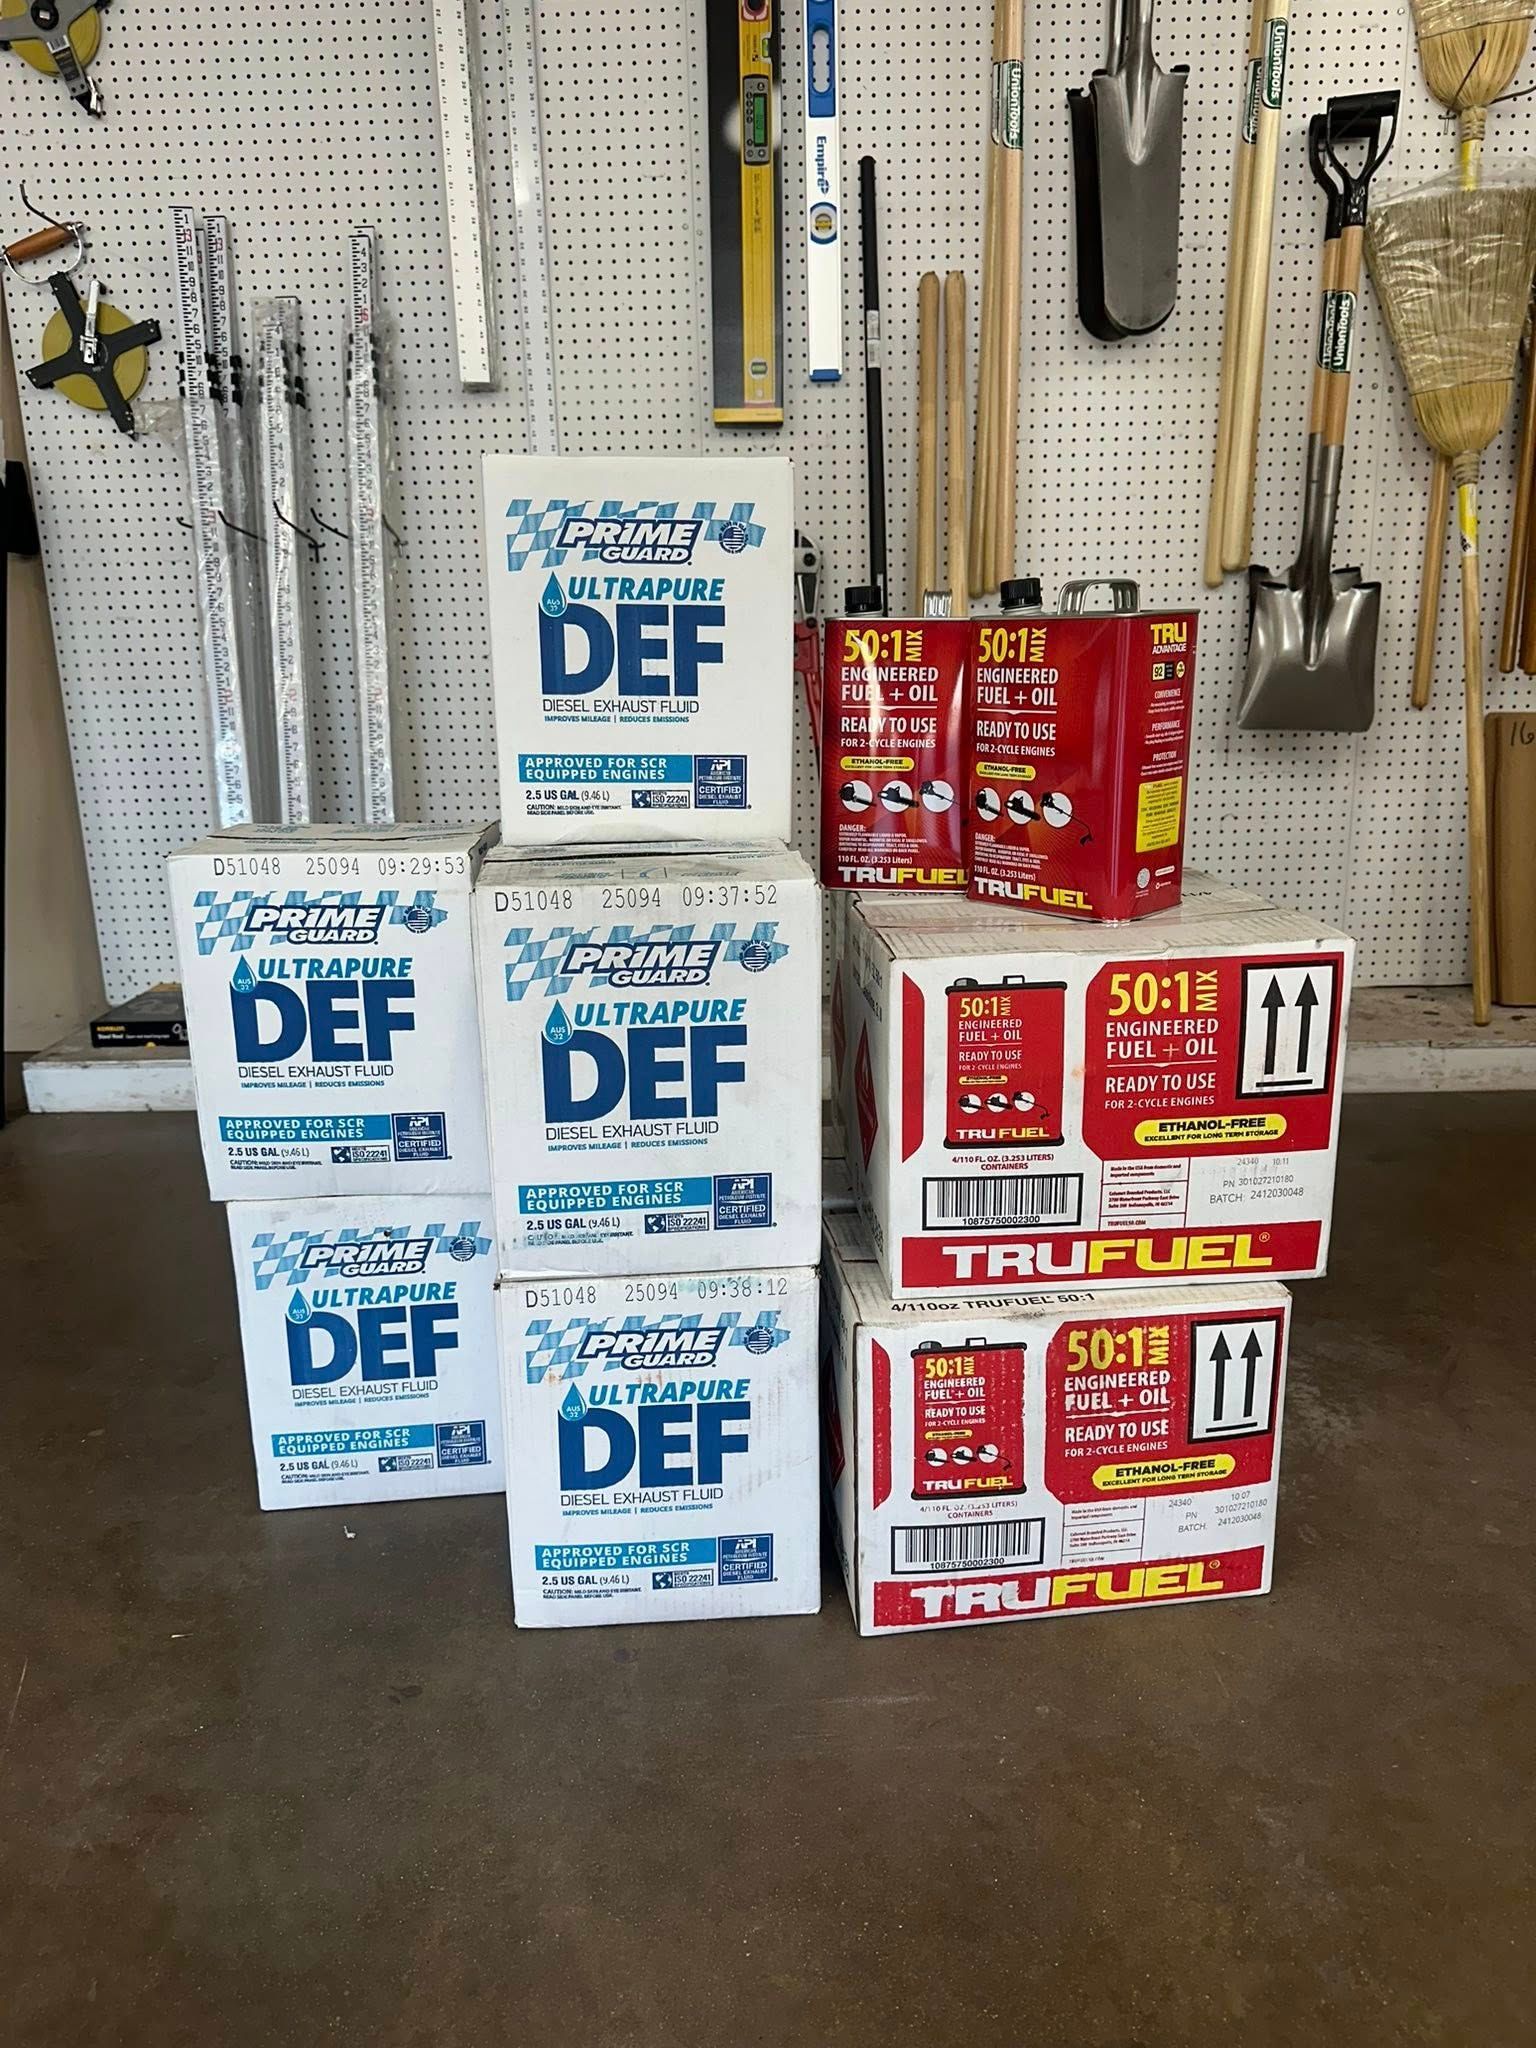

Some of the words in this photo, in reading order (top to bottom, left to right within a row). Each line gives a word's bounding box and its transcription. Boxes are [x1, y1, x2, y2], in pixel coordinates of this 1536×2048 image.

[1271, 25, 1286, 99] UnionTools
[1008, 68, 1022, 140] UnionTools
[815, 135, 827, 187] Empire
[1333, 297, 1351, 366] UnionTools
[560, 520, 693, 546] PRIME
[600, 545, 690, 563] GUARD
[567, 577, 725, 602] ULTRAPURE
[1150, 622, 1187, 645] TRU
[537, 603, 726, 696] DEF
[842, 629, 902, 663] 50:1
[905, 629, 923, 662] MIX
[978, 626, 1028, 664] 50:1
[1029, 627, 1047, 662] MIX
[1151, 643, 1187, 655] ADVANTAGE
[841, 666, 938, 682] ENGINEERED
[976, 666, 1058, 686] ENGINEERED
[1154, 666, 1163, 677] 92
[976, 684, 1010, 705] FUEL
[1031, 686, 1058, 706] OIL
[542, 697, 590, 712] DIESEL
[593, 698, 656, 712] EXHAUST
[660, 699, 699, 714] FLUID
[544, 715, 580, 723] IMPROVES
[619, 716, 651, 724] REDUCES
[652, 716, 689, 724] EMISSIONS
[976, 719, 1011, 739] READY
[1013, 721, 1029, 739] TO
[1032, 722, 1056, 741] USE
[1511, 720, 1535, 747] 16
[976, 741, 989, 753] FOR
[990, 742, 1019, 755] 2-CYCLE
[1020, 744, 1055, 758] ENGINES
[524, 757, 602, 769] APPROVED
[607, 757, 638, 769] FOR
[640, 757, 667, 769] SCR
[983, 763, 1026, 774] ETHANOL-FREE
[525, 768, 598, 781] EQUIPPED
[603, 768, 665, 781] ENGINES
[214, 857, 281, 876] D51048
[306, 857, 360, 875] 25094
[378, 857, 465, 875] 09:29:53
[493, 889, 573, 913] D51048
[601, 886, 660, 910] 25094
[681, 883, 777, 908] 09:37:52
[247, 906, 379, 931] PRIME
[286, 927, 376, 945] GUARD
[565, 942, 711, 972] PRIME
[256, 955, 413, 980] ULTRAPURE
[609, 966, 708, 988] GUARD
[1107, 970, 1189, 1016] 50:1
[1194, 969, 1219, 1012] MIX
[229, 978, 419, 1064] DEF
[573, 997, 747, 1028] ULTRAPURE
[1105, 1018, 1219, 1038] ENGINEERED
[1106, 1039, 1157, 1060] FUEL
[1185, 1036, 1218, 1056] OIL
[238, 1065, 285, 1079] DIESEL
[288, 1064, 351, 1078] EXHAUST
[354, 1064, 394, 1077] FLUID
[539, 1023, 747, 1124] DEF
[1104, 1075, 1157, 1093] READY
[1161, 1074, 1182, 1091] TO
[1185, 1072, 1216, 1089] USE
[1104, 1099, 1124, 1109] FOR
[1127, 1097, 1168, 1108] 2-CYCLE
[1170, 1095, 1215, 1107] ENGINES
[545, 1124, 598, 1141] DIESEL
[602, 1121, 671, 1139] EXHAUST
[675, 1120, 719, 1136] FLUID
[1158, 1117, 1266, 1132] ETHANOL-FREE
[547, 1143, 587, 1152] IMPROVES
[588, 1141, 622, 1150] MILEAGE
[630, 1139, 666, 1148] REDUCES
[667, 1137, 708, 1147] EMISSIONS
[1144, 1134, 1185, 1142] EXCELLENT
[1225, 1130, 1244, 1138] TERM
[1245, 1128, 1279, 1136] STORAGE
[951, 1155, 974, 1163] 4/110
[974, 1155, 987, 1163] FL.
[1000, 1154, 1025, 1162] (3.253
[1025, 1153, 1054, 1162] LITERS)
[980, 1162, 1028, 1171] CONTAINERS
[525, 1184, 611, 1200] APPROVED
[617, 1182, 651, 1195] FOR
[654, 1180, 684, 1194] SCR
[1223, 1179, 1235, 1188] PN
[1238, 1174, 1294, 1186] 301027210180
[526, 1196, 607, 1212] EQUIPPED
[612, 1191, 681, 1207] ENGINES
[1250, 1187, 1304, 1200] 2412030048
[718, 1203, 765, 1215] CERTIFIED
[526, 1219, 544, 1231] 2.5
[546, 1218, 562, 1230] US
[563, 1217, 586, 1229] GAL
[667, 1218, 682, 1226] ISO
[682, 1216, 706, 1225] 22241
[962, 1214, 1040, 1226] 10875750002300
[303, 1239, 426, 1266] PRIME
[340, 1258, 423, 1278] GUARD
[311, 1281, 458, 1310] ULTRAPURE
[525, 1285, 597, 1308] D51048
[624, 1281, 678, 1303] 25094
[697, 1277, 788, 1299] 09:38:12
[891, 1300, 961, 1312] 4/110oz
[1056, 1292, 1096, 1304] 50:1
[284, 1302, 462, 1386] DEF
[581, 1328, 718, 1357] PRIME
[1066, 1328, 1143, 1373] 50:1
[1148, 1326, 1170, 1366] MIX
[621, 1350, 714, 1371] GUARD
[588, 1377, 750, 1406] ULTRAPURE
[557, 1400, 751, 1492] DEF
[1115, 1459, 1215, 1477] ETHANOL-FREE
[560, 1492, 610, 1507] DIESEL
[613, 1488, 678, 1504] EXHAUST
[682, 1487, 723, 1501] FLUID
[1168, 1497, 1193, 1509] 24340
[947, 1508, 993, 1519] CONTAINERS
[930, 1556, 1005, 1570] 10875750002300
